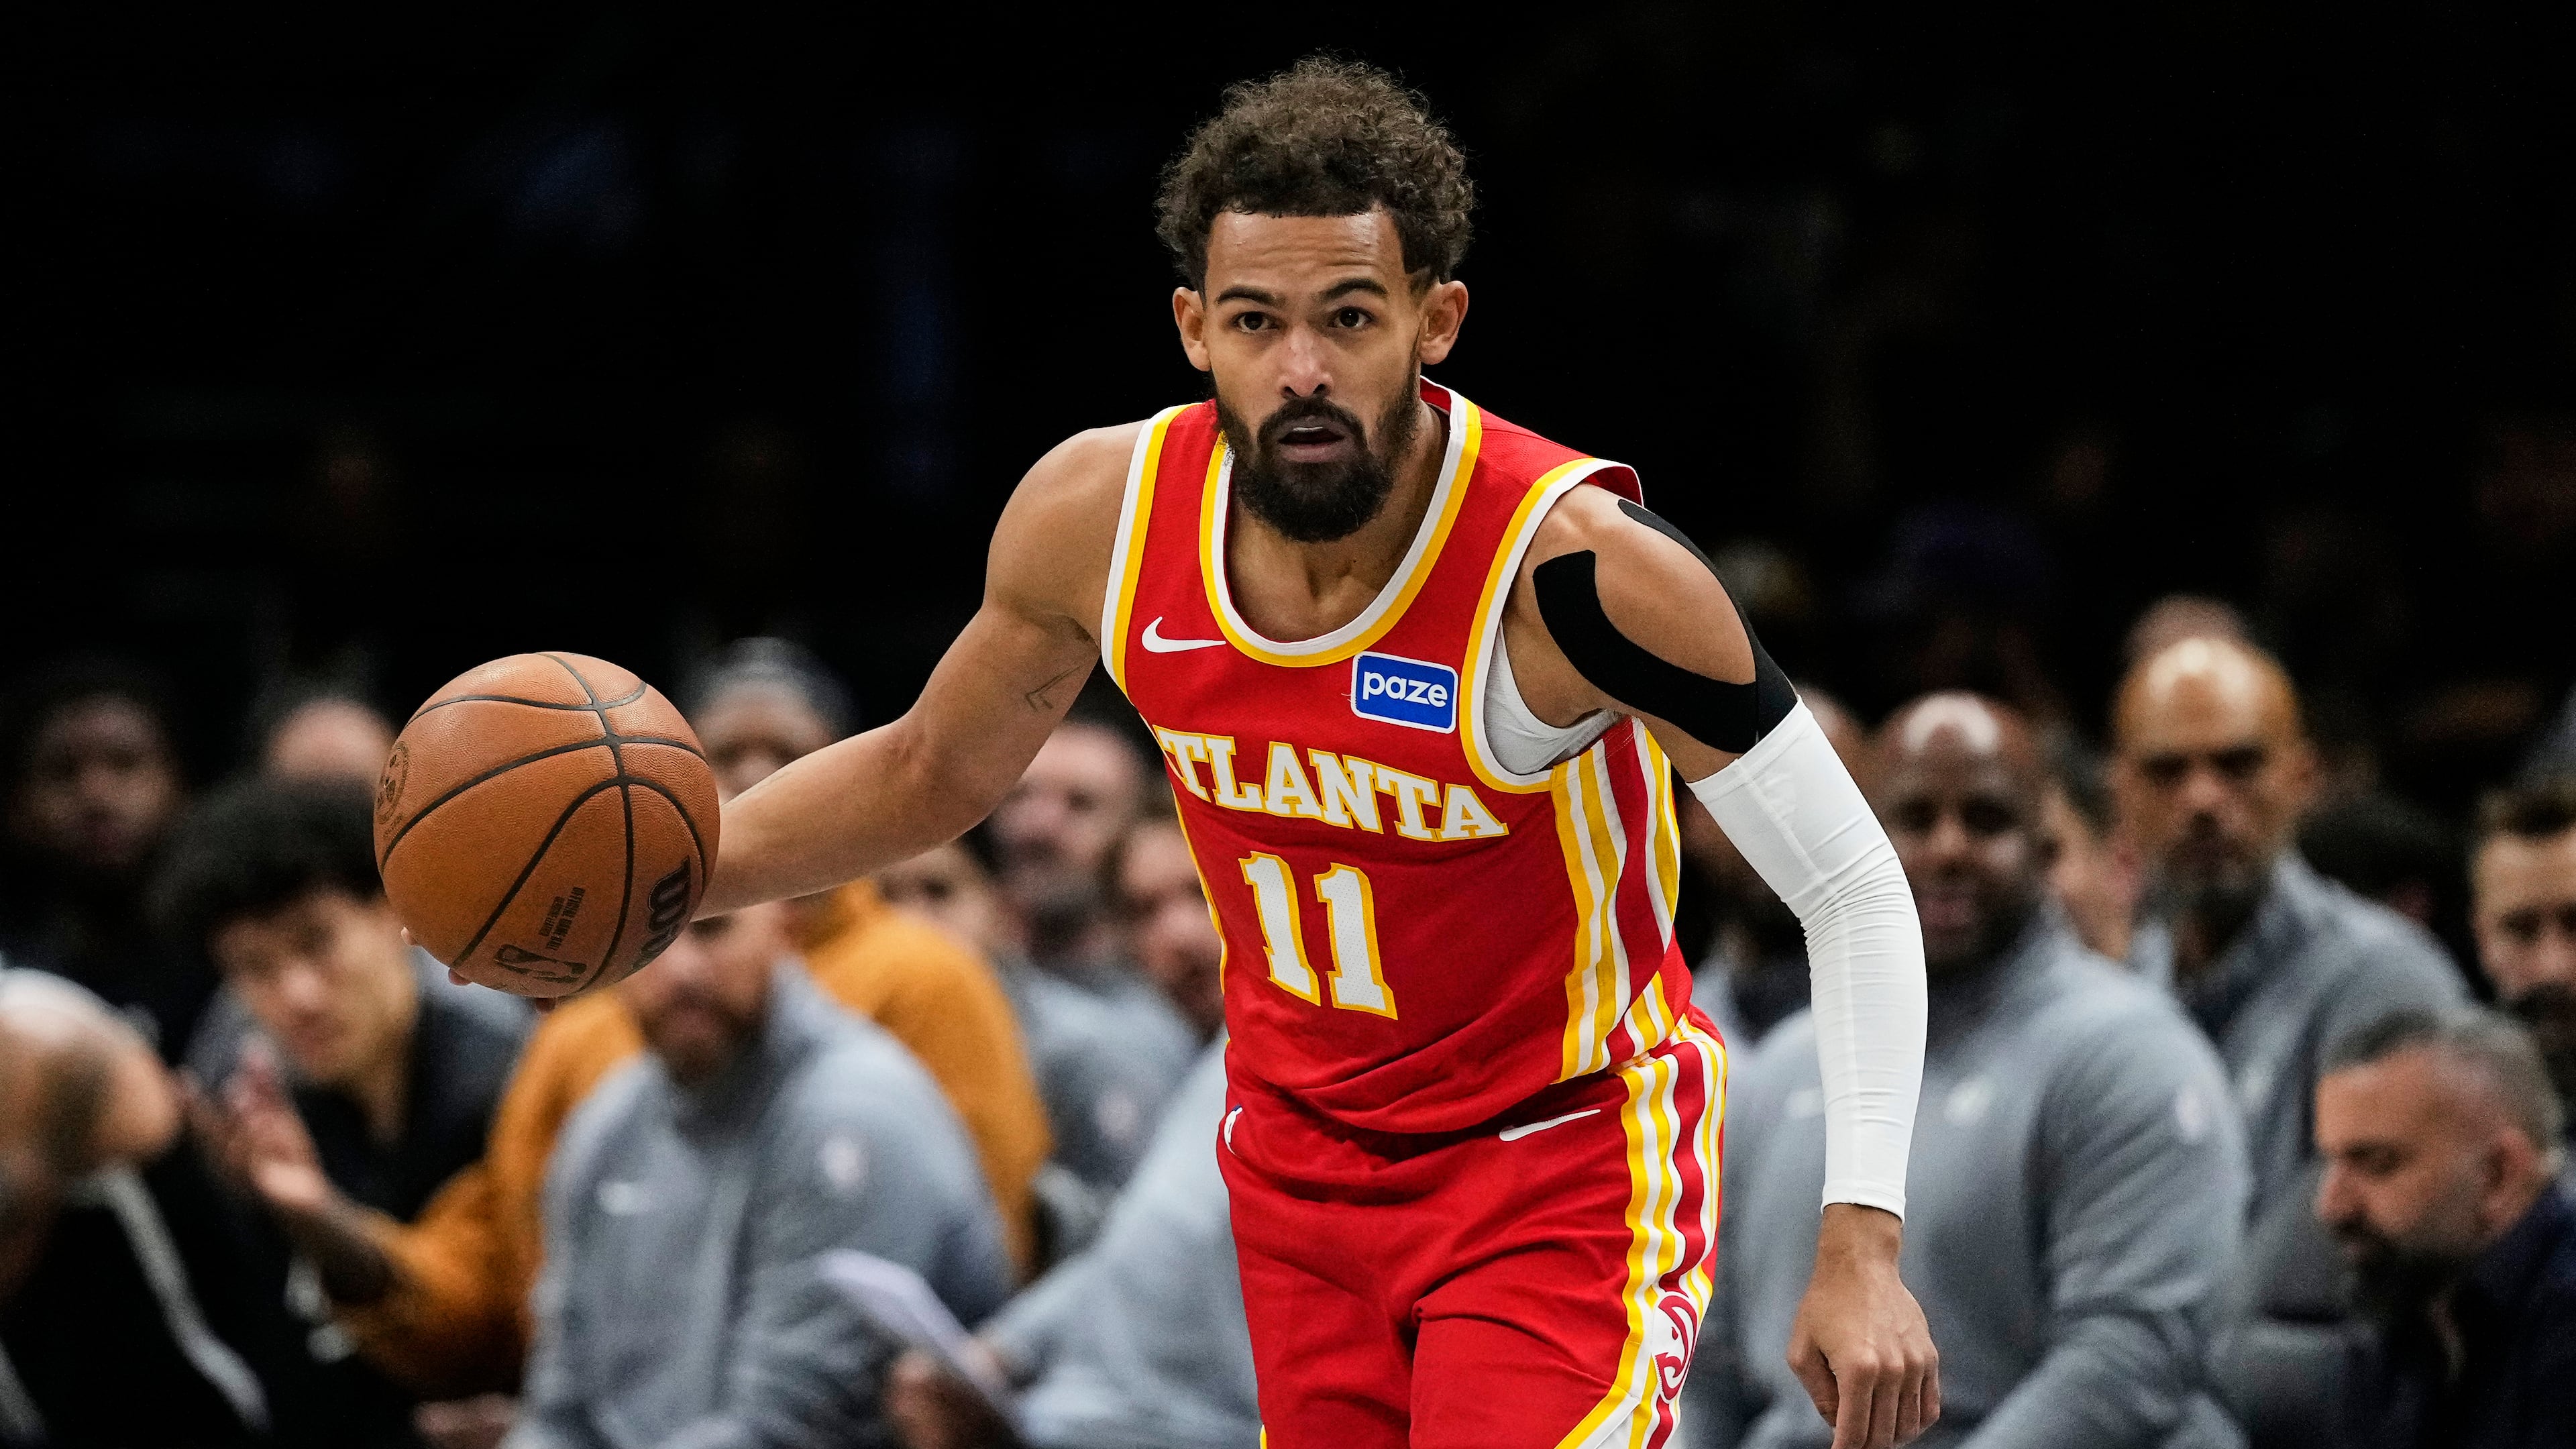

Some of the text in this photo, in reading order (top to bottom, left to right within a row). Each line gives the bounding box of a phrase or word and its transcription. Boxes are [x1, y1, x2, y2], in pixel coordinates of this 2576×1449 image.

[1362, 672, 1448, 708] paze
[1152, 724, 1509, 842] TLANTA
[1238, 851, 1398, 1020] 11
